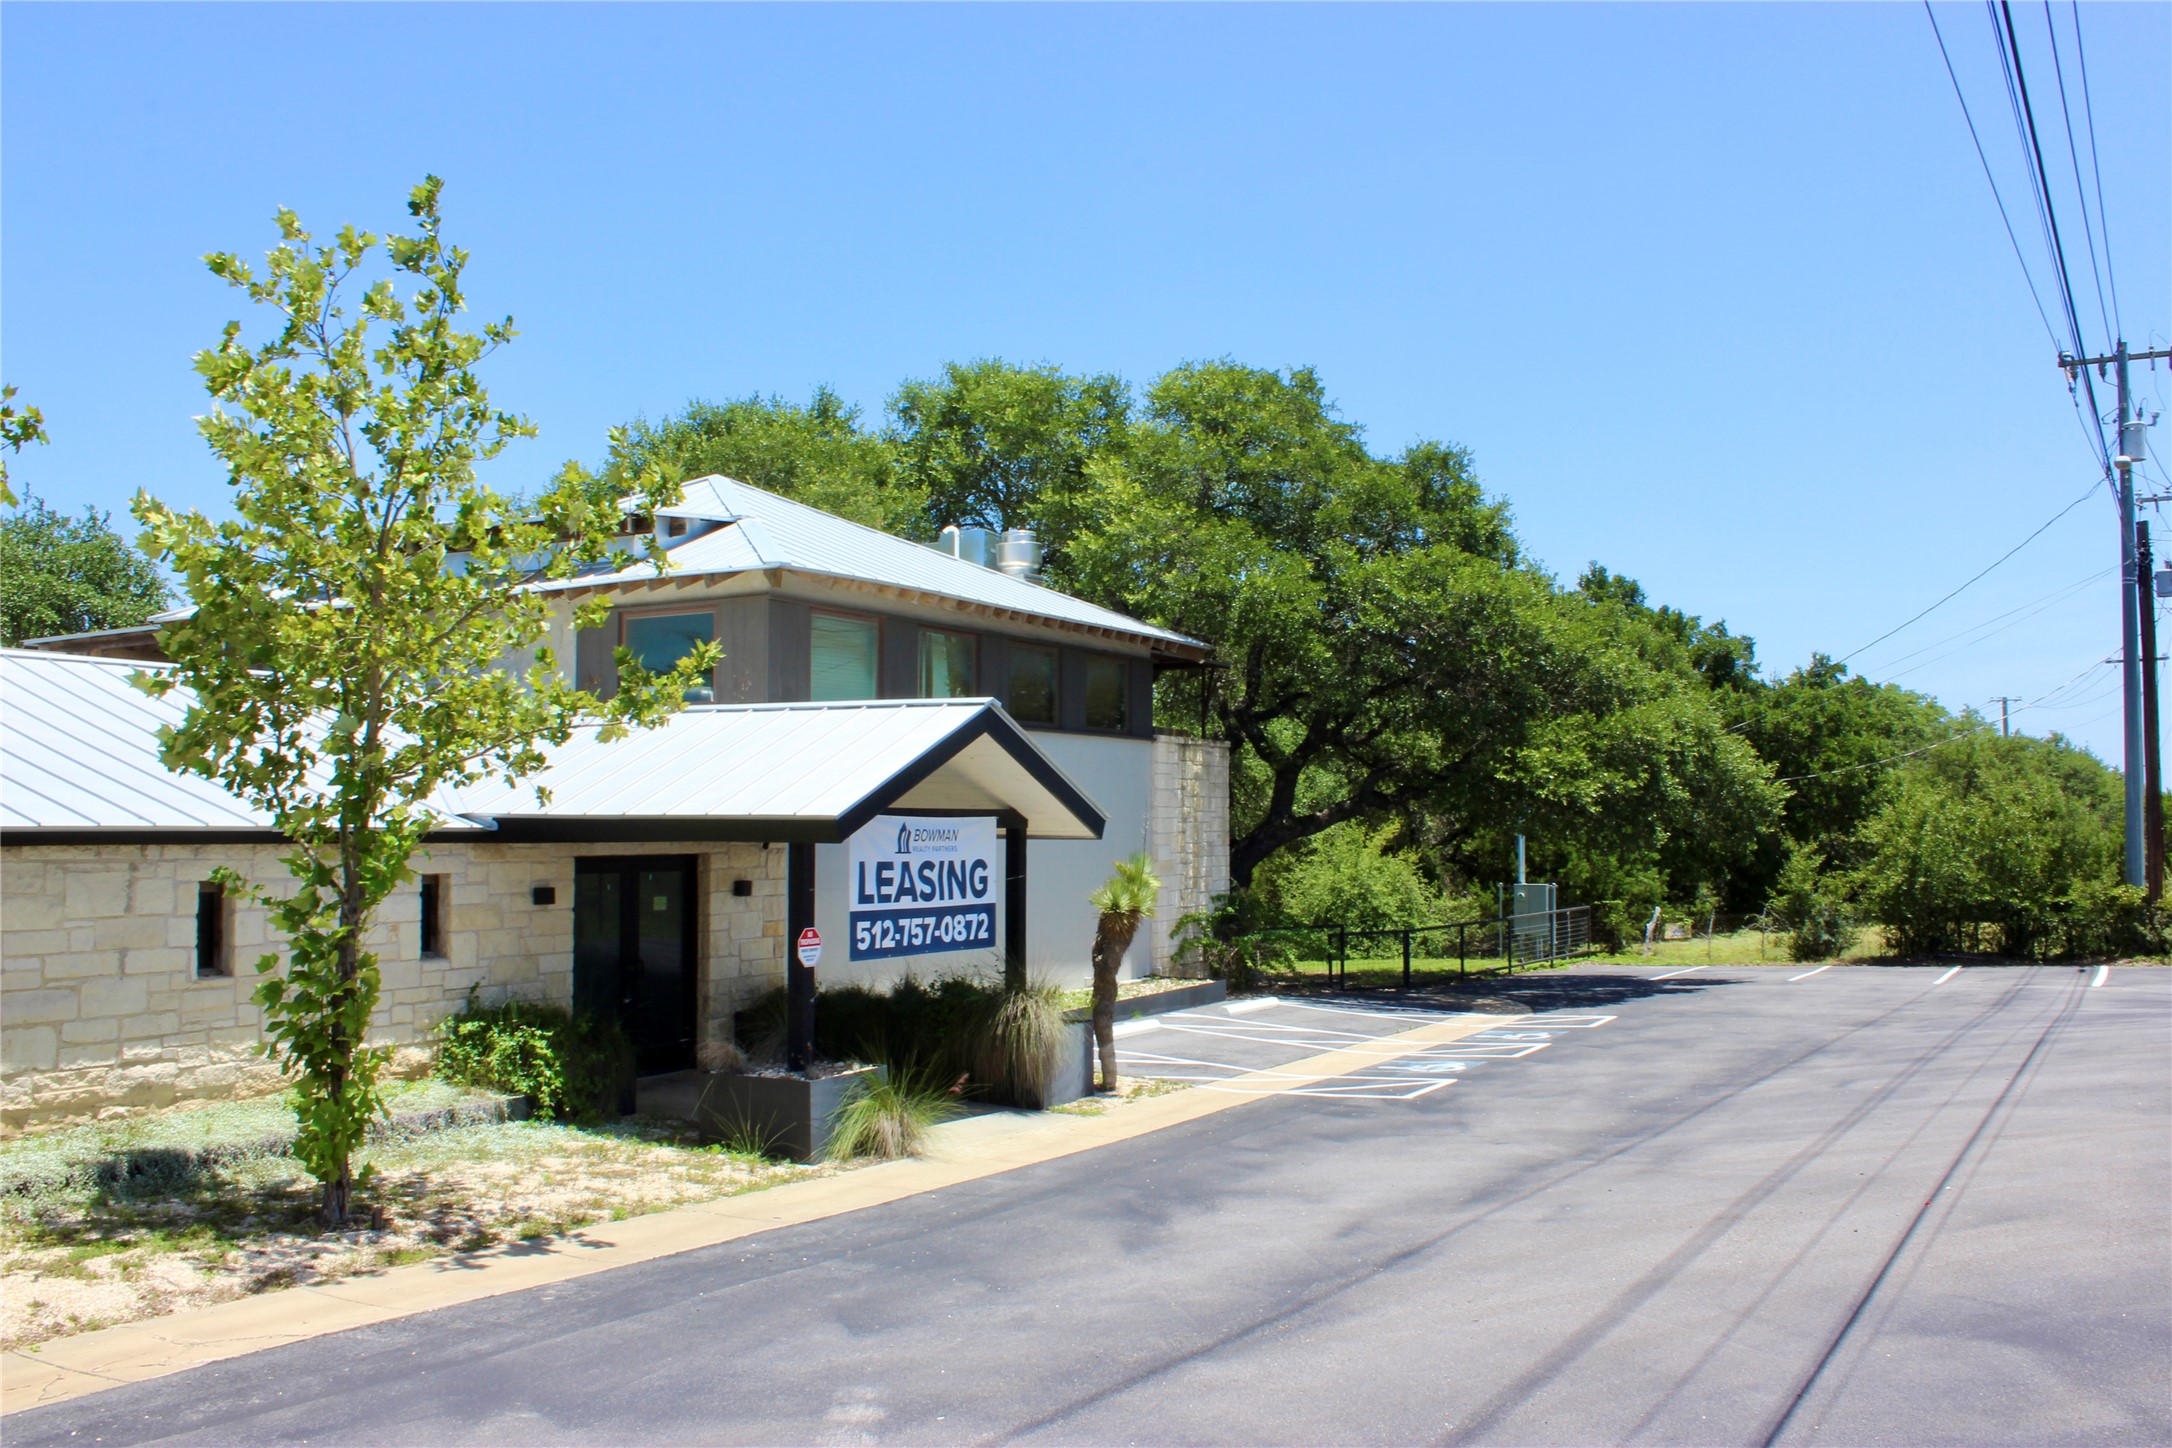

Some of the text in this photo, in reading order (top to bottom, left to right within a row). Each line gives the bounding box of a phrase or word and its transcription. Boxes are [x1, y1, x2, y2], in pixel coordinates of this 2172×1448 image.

[913, 828, 959, 842] BOWMAN
[932, 845, 958, 853] PARTNERS
[858, 858, 988, 904] LEASING
[856, 912, 989, 951] 512-757-0872
